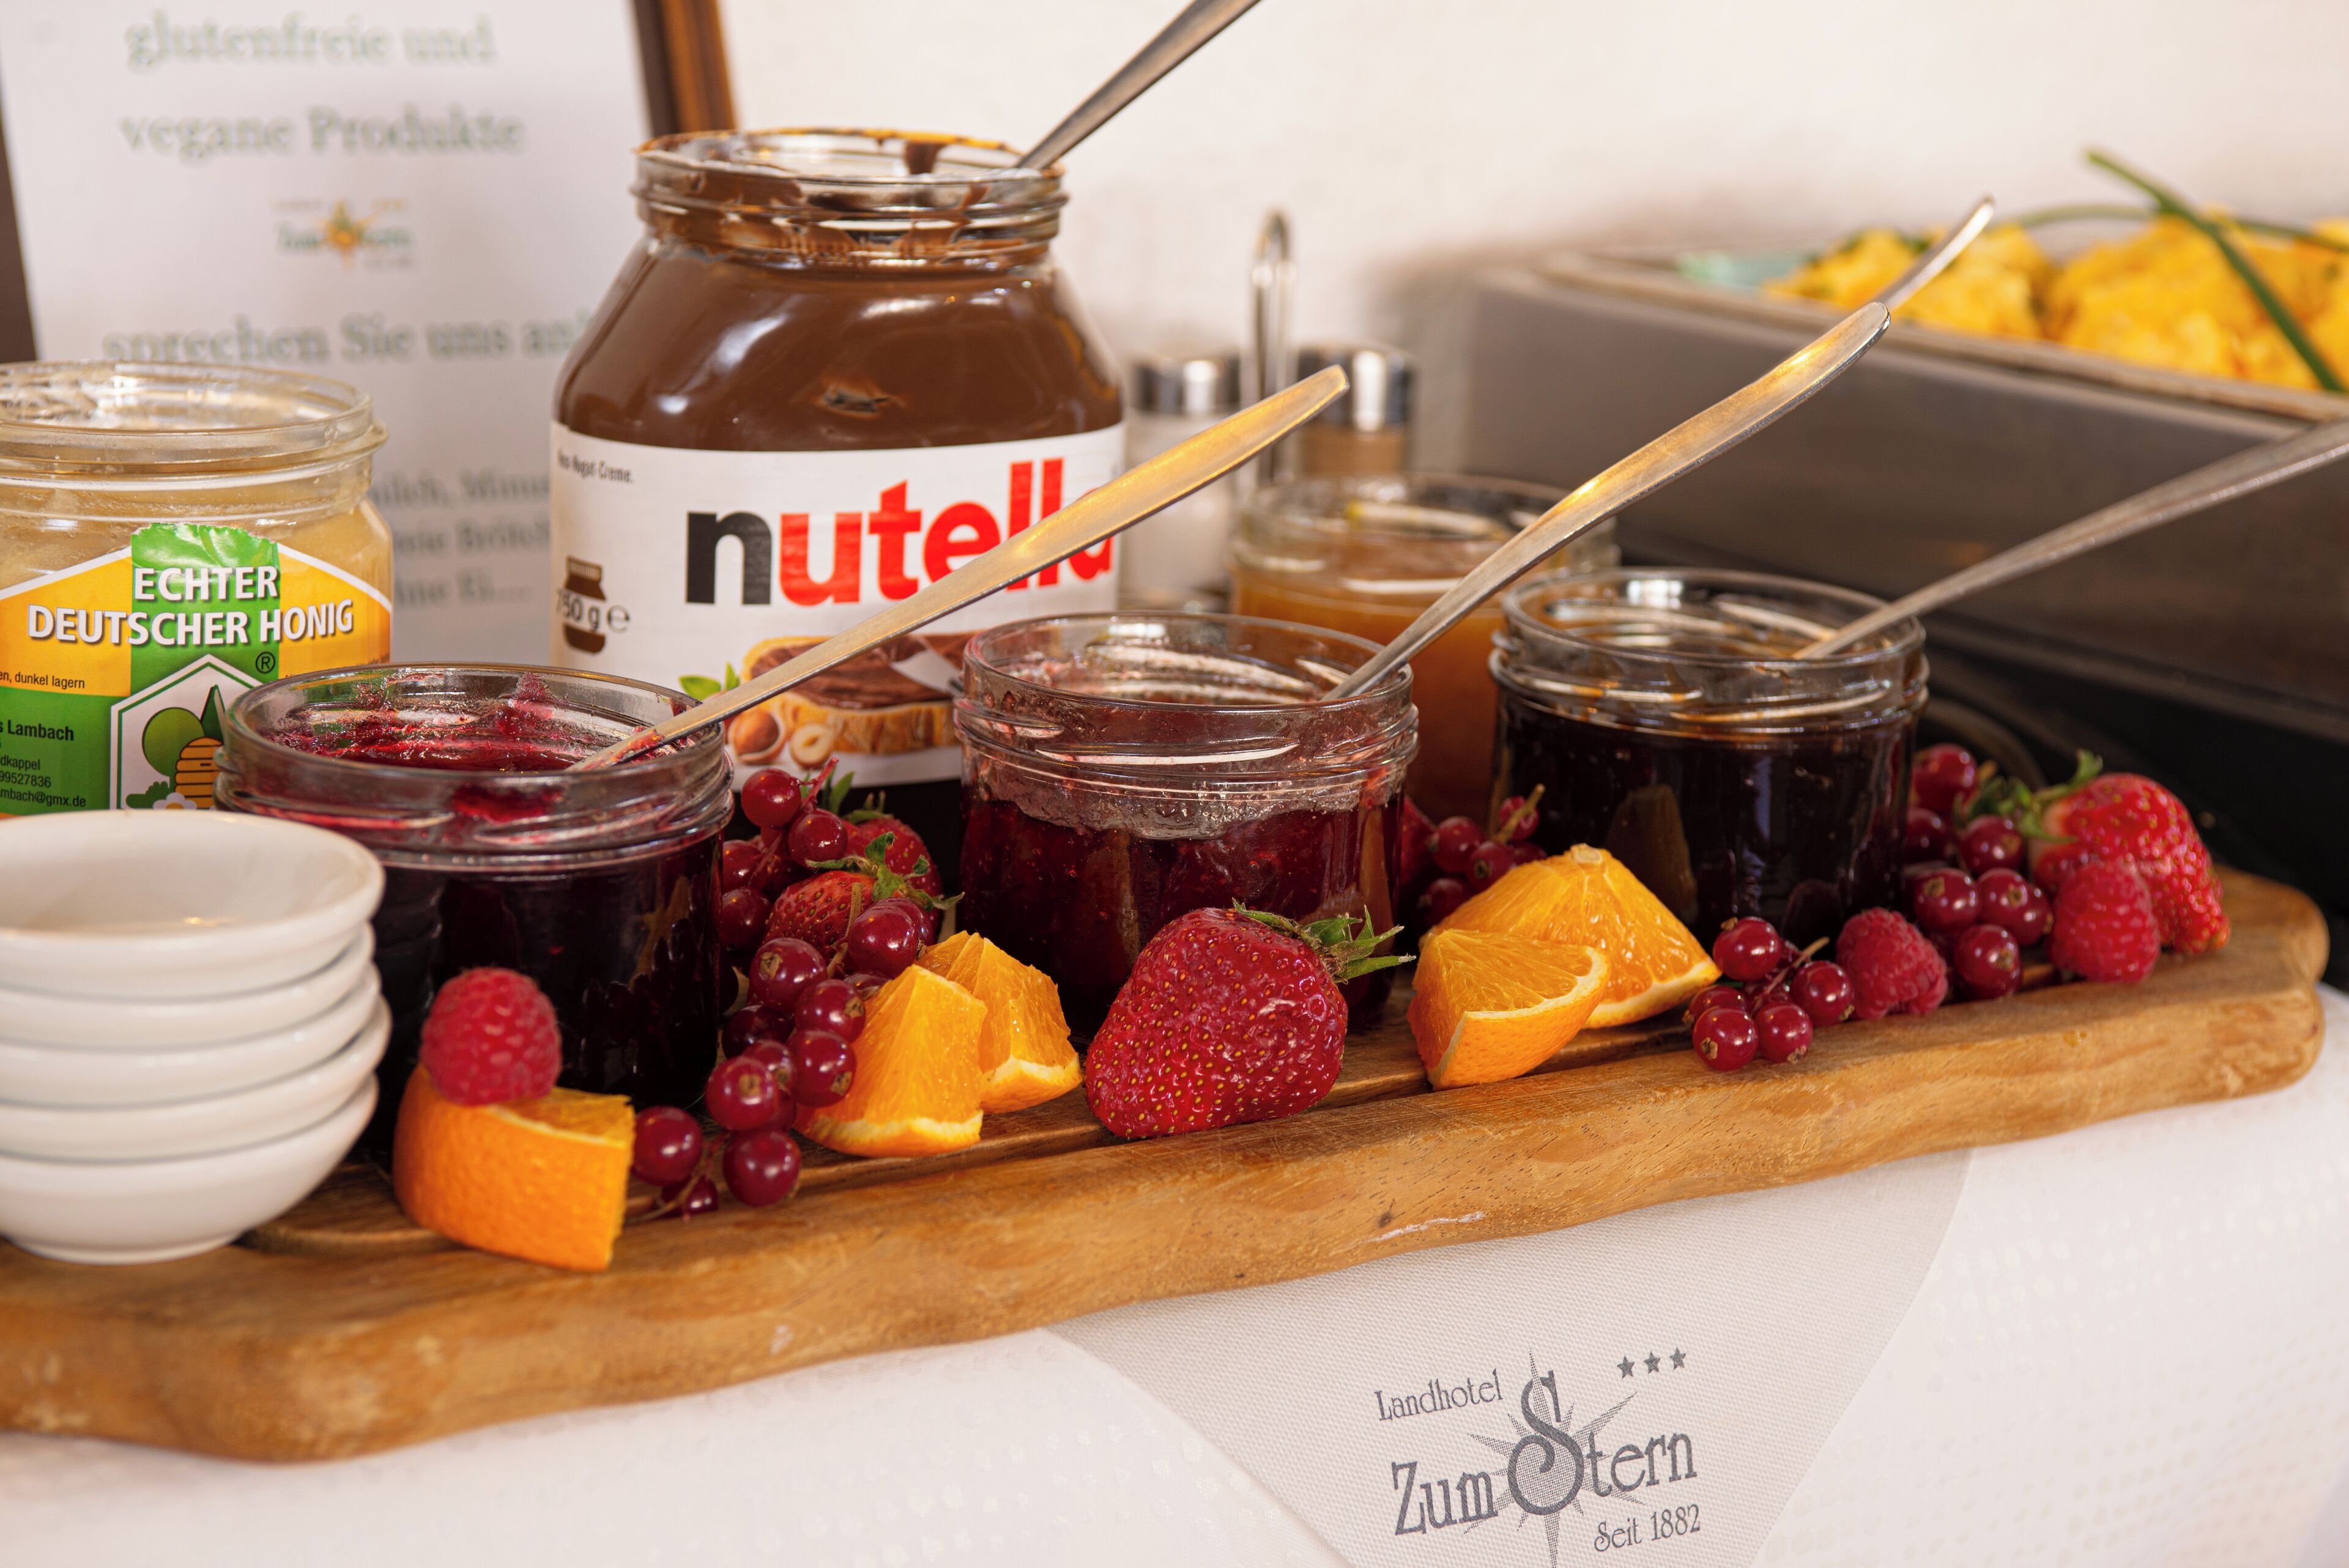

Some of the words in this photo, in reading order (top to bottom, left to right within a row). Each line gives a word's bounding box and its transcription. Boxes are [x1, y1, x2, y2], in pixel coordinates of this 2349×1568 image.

[404, 18, 495, 62] und
[119, 112, 292, 157] vegane
[308, 104, 524, 152] Produkte
[341, 313, 412, 363] Sie
[134, 566, 279, 601] ECHTER
[28, 604, 249, 645] DEUTSCHER
[259, 599, 354, 643] HONIG
[15, 671, 48, 686] dunkel
[52, 675, 85, 689] lagern
[7, 719, 74, 741] Lambach
[1374, 1368, 1503, 1422] Landhotel
[1391, 1460, 1499, 1536] Zum
[1507, 1369, 1698, 1515] Stern
[1594, 1517, 1642, 1552] Seit
[1650, 1503, 1701, 1542] 1882
